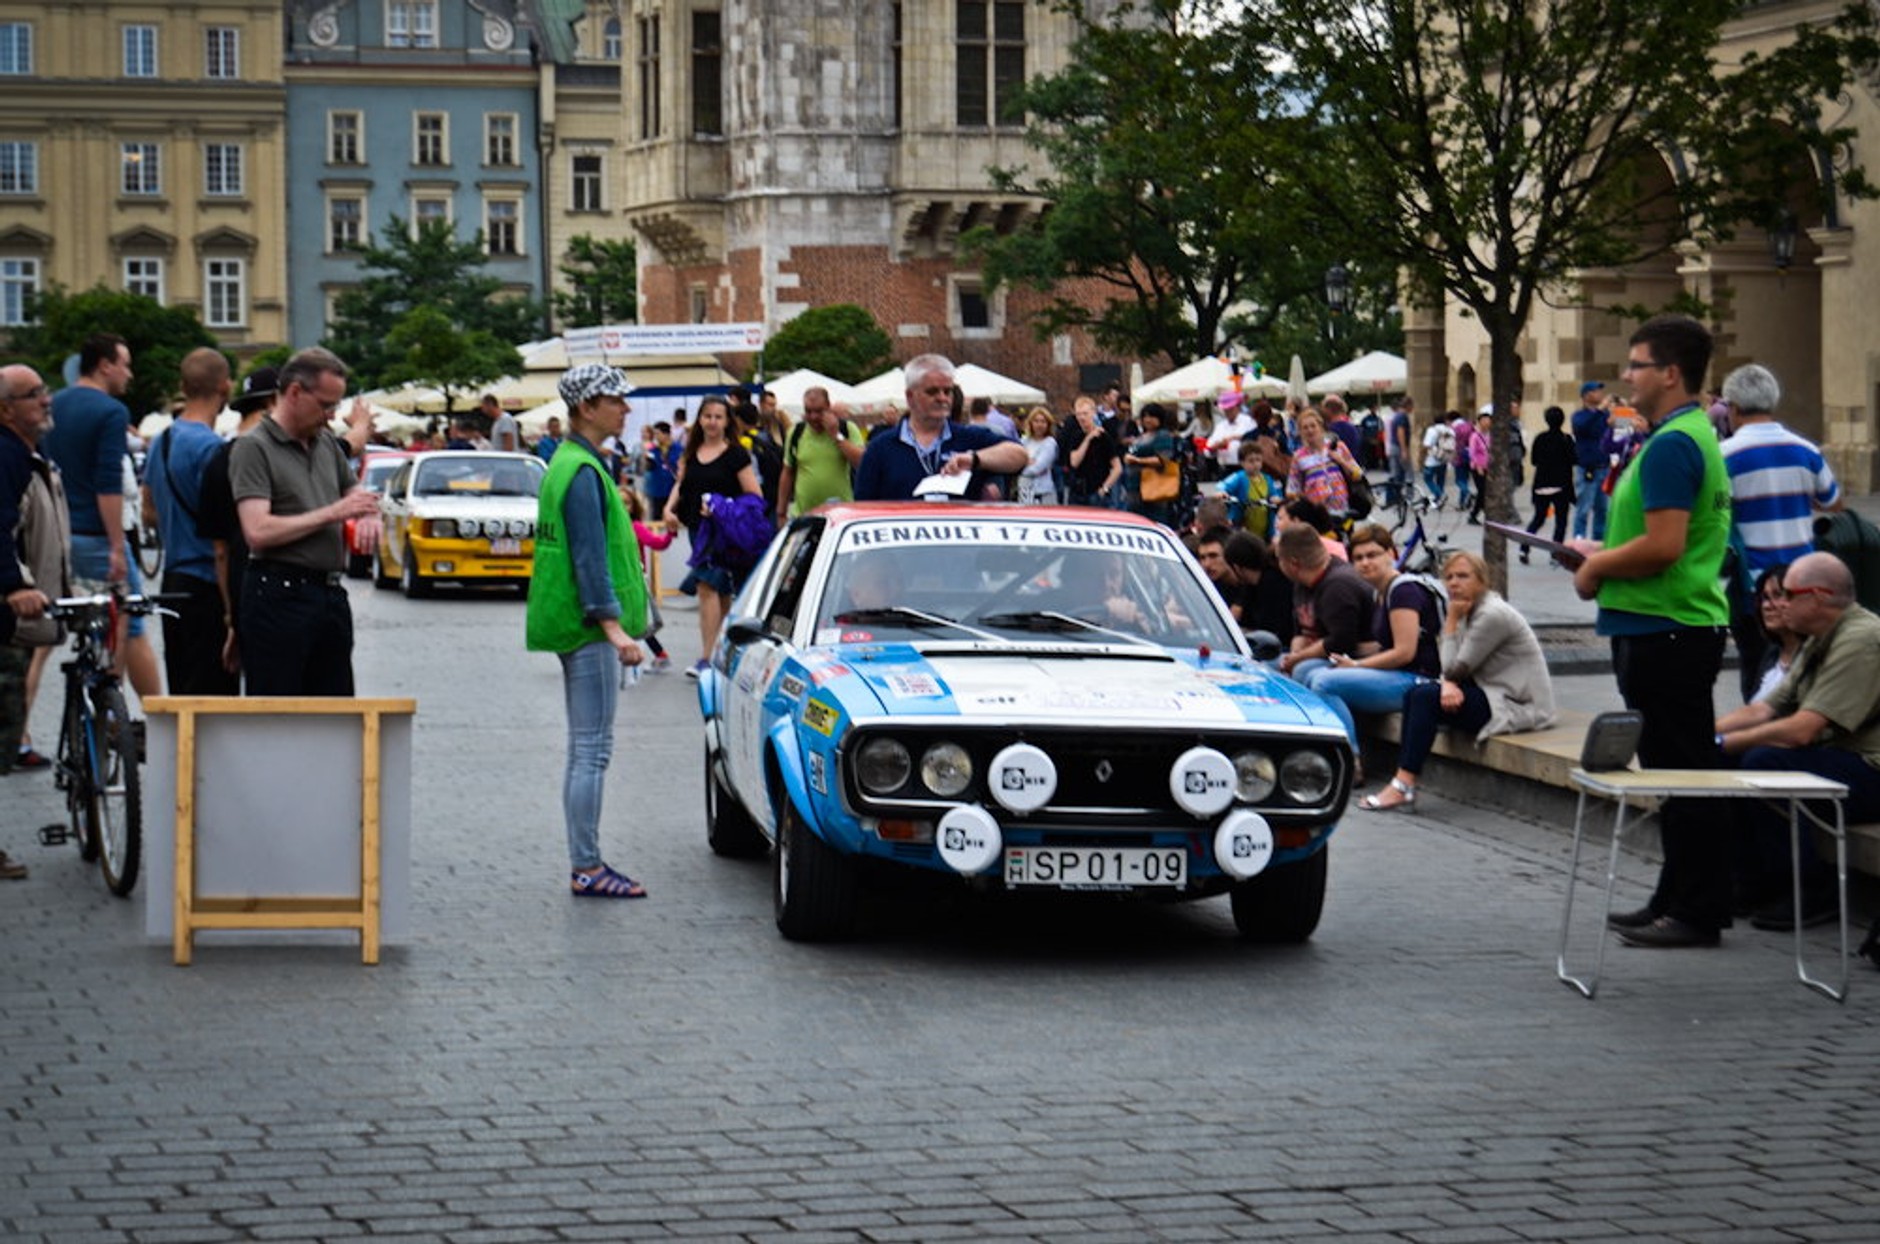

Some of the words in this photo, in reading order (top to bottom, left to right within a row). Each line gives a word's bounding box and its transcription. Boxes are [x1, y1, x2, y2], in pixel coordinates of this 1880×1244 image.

[852, 525, 981, 546] RENAULT
[998, 526, 1029, 540] 17
[1043, 527, 1166, 554] GORDINI
[1009, 867, 1024, 881] H
